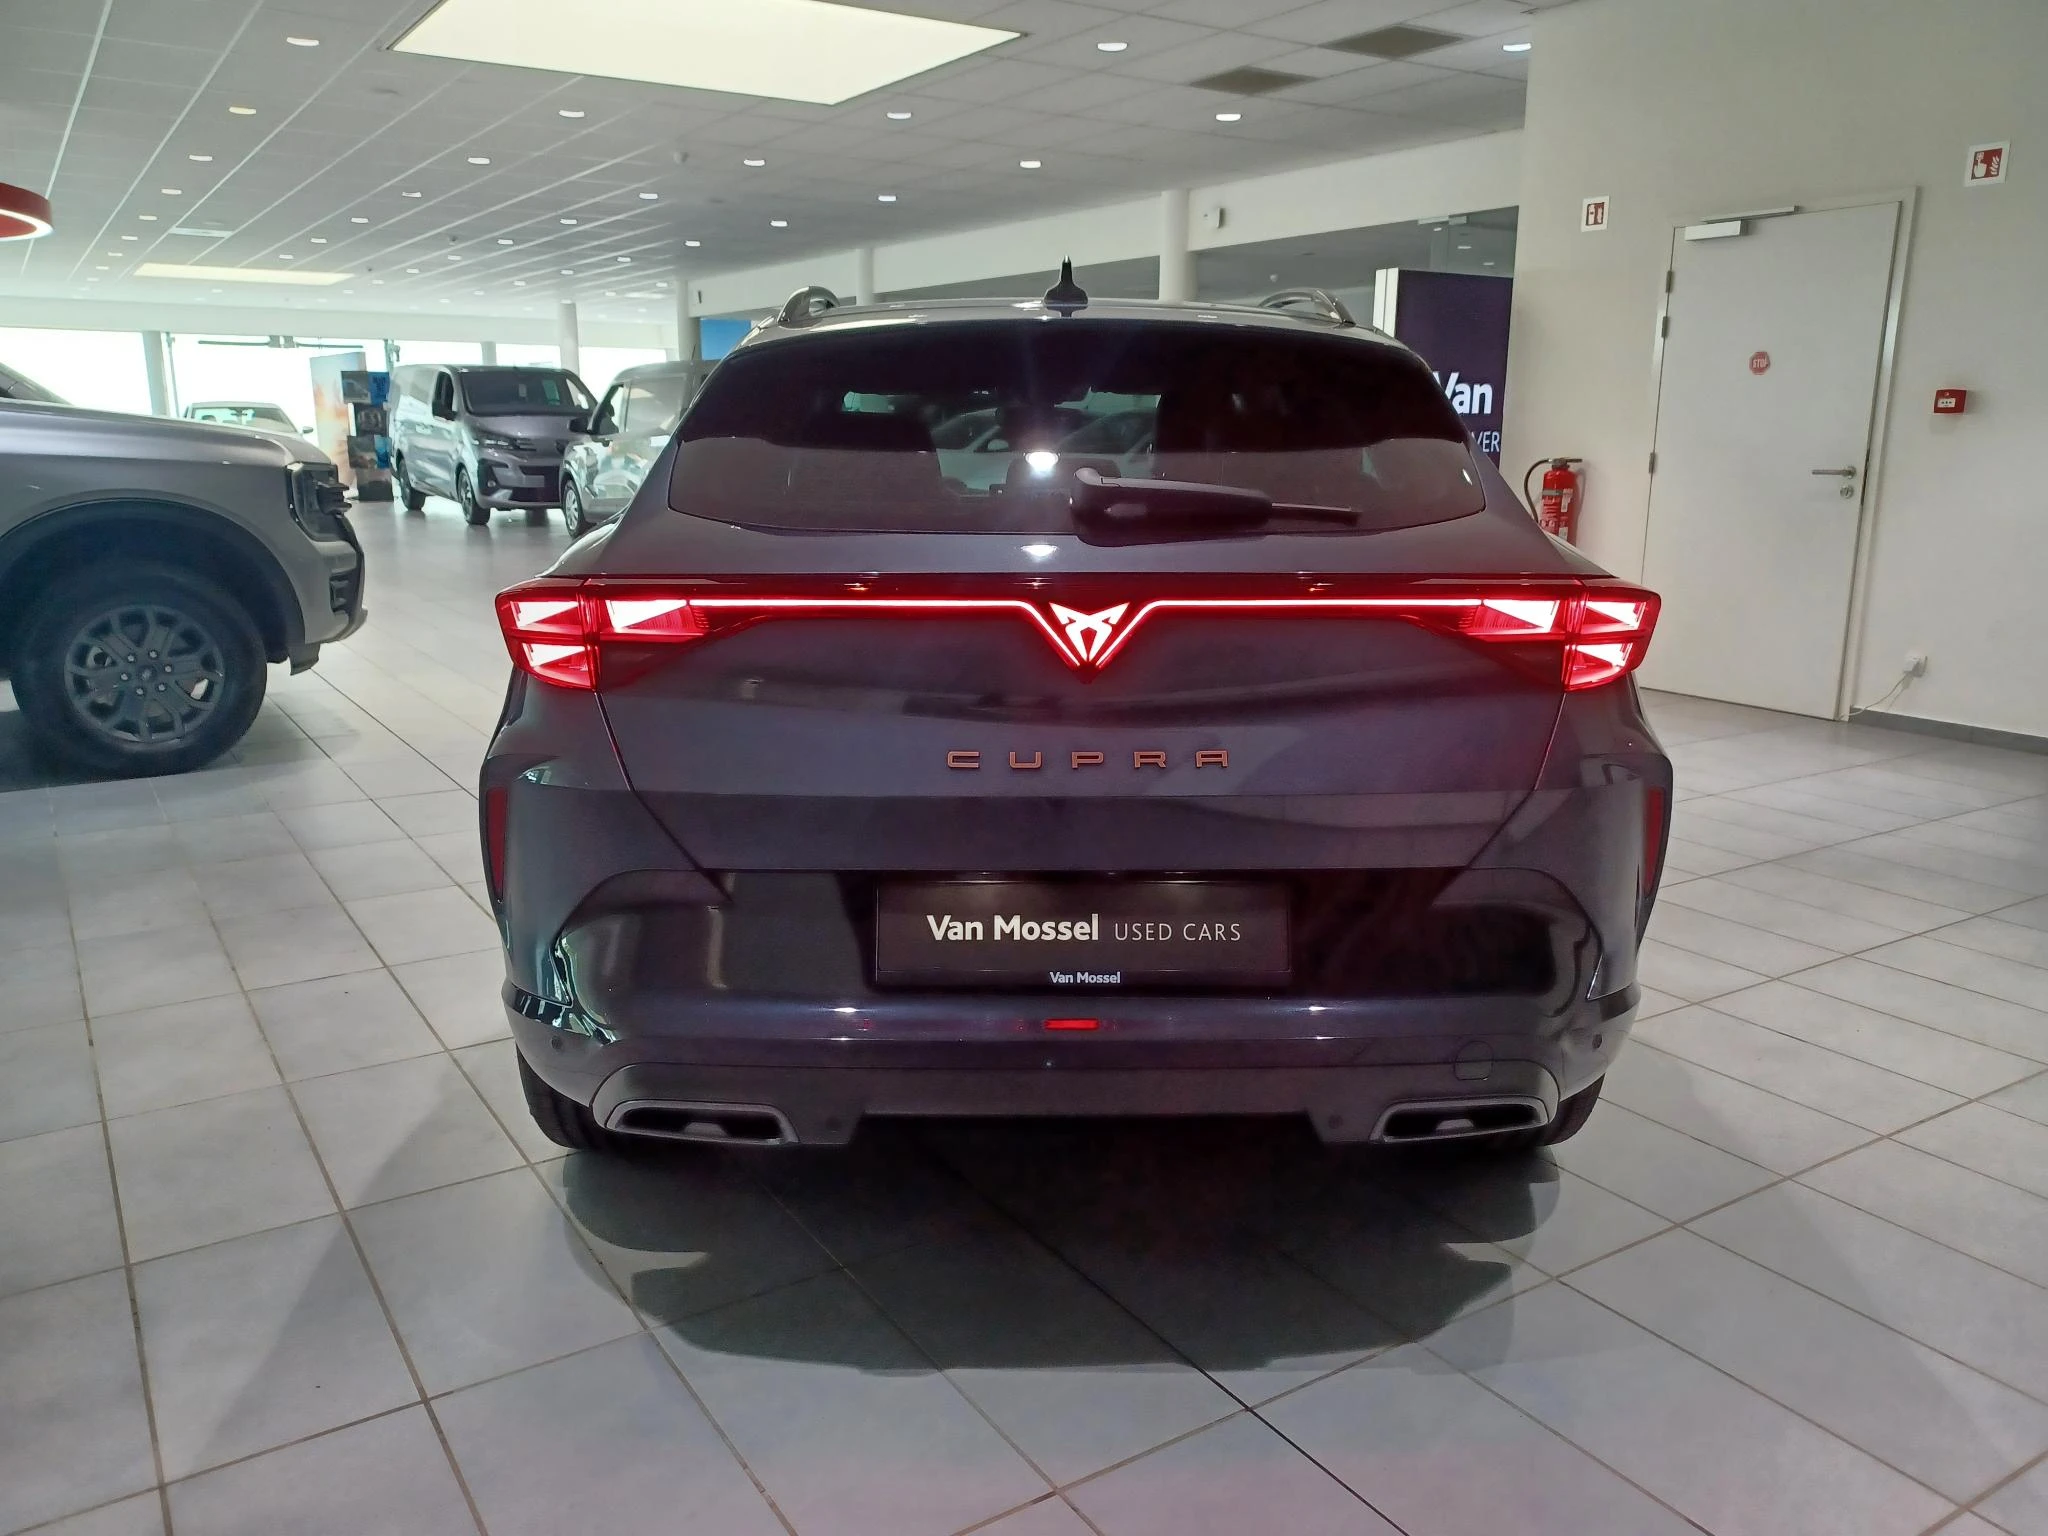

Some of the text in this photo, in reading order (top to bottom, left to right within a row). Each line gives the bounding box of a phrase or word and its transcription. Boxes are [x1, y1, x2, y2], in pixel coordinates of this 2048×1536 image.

[1752, 357, 1769, 368] STOP
[1432, 371, 1493, 415] Van
[946, 750, 1229, 769] CUPRA
[927, 912, 1242, 942] Van Mossel USED CARS
[1049, 970, 1121, 984] Van Mossel
